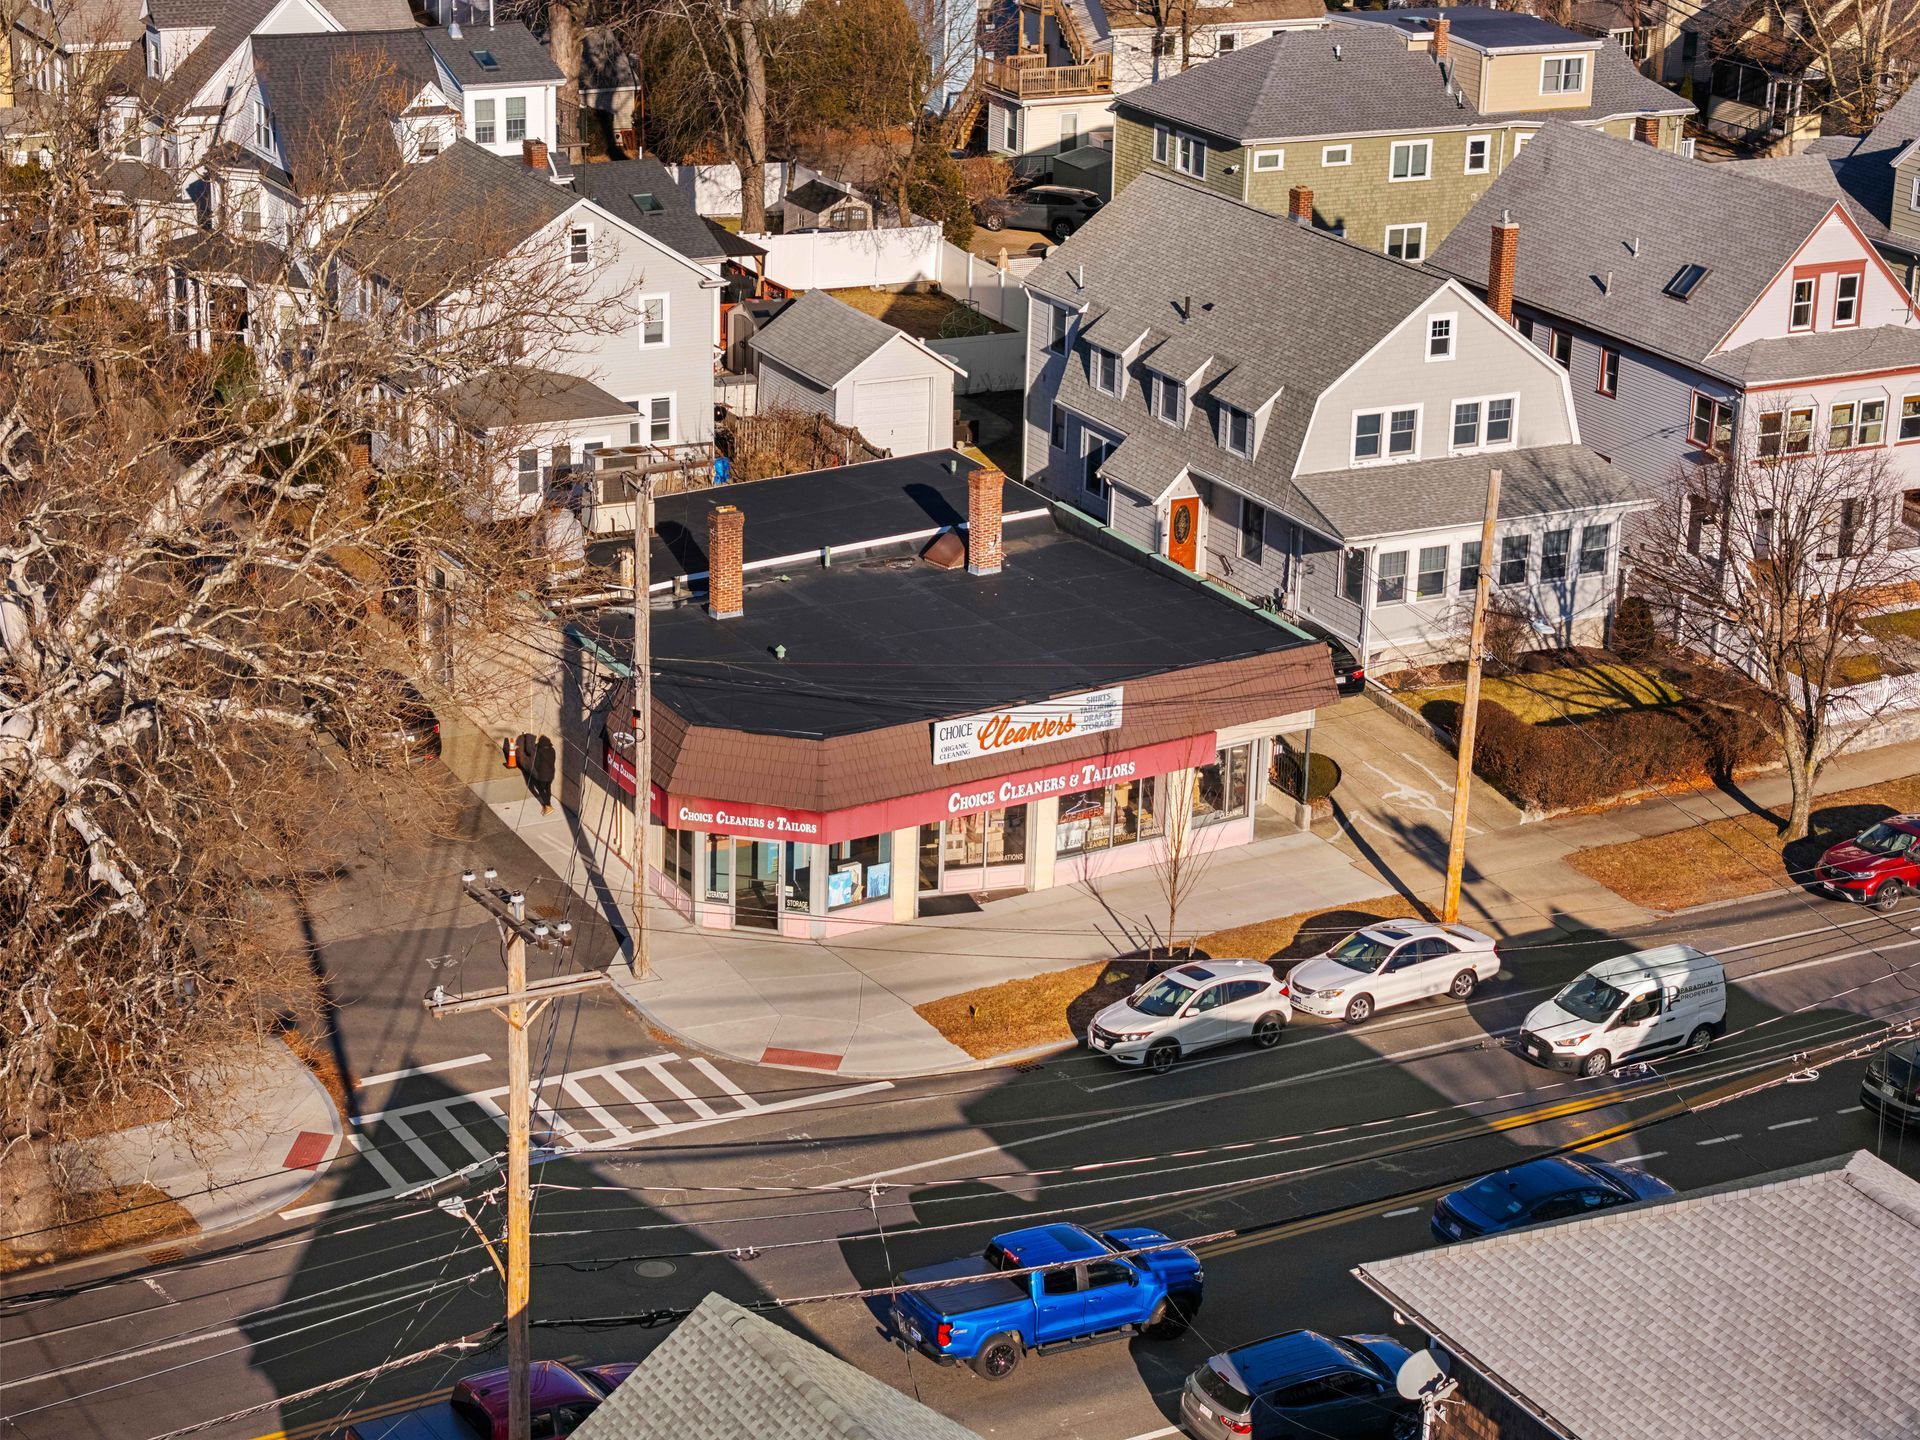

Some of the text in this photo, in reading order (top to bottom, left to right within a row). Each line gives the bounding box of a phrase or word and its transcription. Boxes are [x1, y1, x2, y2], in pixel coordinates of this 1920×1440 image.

[1086, 693, 1111, 704] SHIRTS
[1080, 700, 1117, 714] TAILORING
[1084, 711, 1112, 722] DRAPES
[977, 712, 1077, 750] Cleansers
[1080, 719, 1115, 731] STORAGE
[939, 723, 973, 741] CHOICE
[940, 742, 969, 754] ORGANIC
[939, 749, 971, 761] CLEANING
[948, 761, 1136, 813] CHOICE CLEANERS & TAILORS
[680, 807, 817, 834] CHOICE CLEANERS & TAILORS
[786, 899, 809, 909] STORAGE
[1681, 987, 1719, 1001] PROPERTIES
